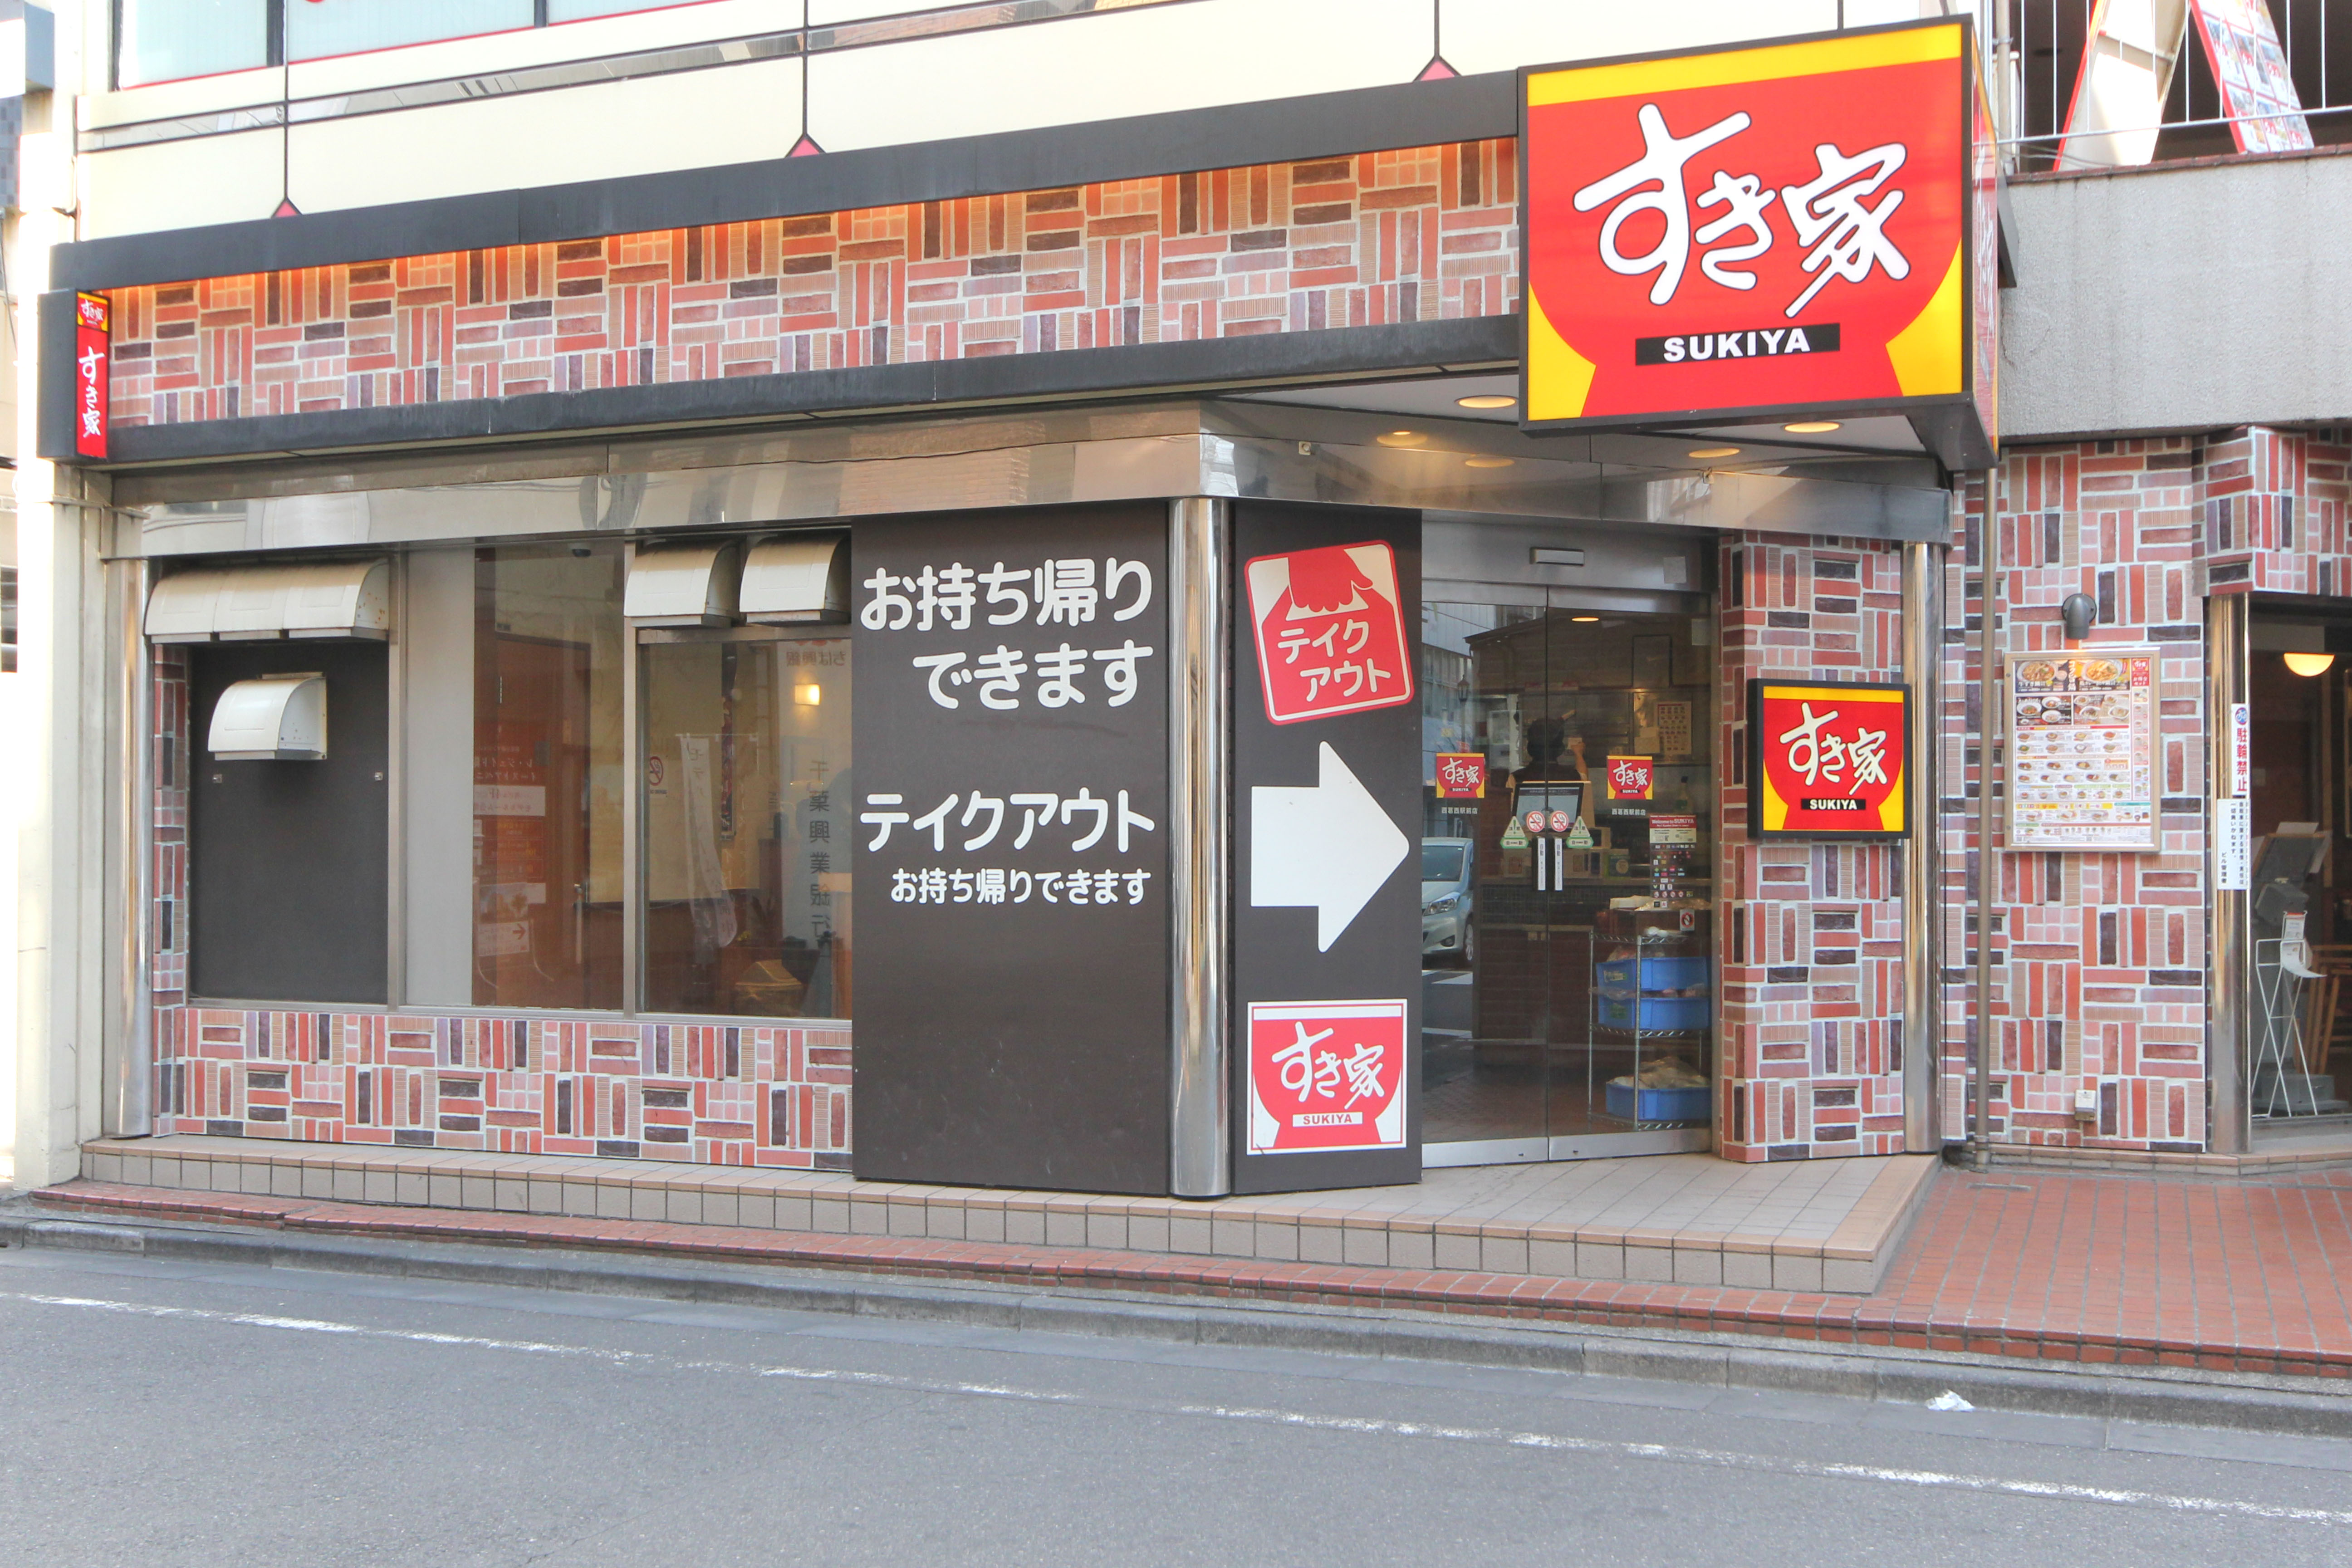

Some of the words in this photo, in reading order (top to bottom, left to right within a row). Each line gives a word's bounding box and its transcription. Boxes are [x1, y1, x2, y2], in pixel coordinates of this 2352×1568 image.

[1573, 103, 1910, 318] すき家
[81, 299, 103, 322] すき家
[1663, 326, 1811, 362] SUKIYA
[78, 345, 105, 438] すき家
[861, 557, 1152, 631] お持ち帰り
[1278, 619, 1369, 665] テイク
[912, 639, 1154, 710] できます
[1299, 658, 1391, 701] アウト
[1779, 702, 1887, 796] すき家
[2236, 727, 2247, 792] 駐輪禁止
[1442, 757, 1479, 789] すき家
[1613, 760, 1648, 789] すき家
[860, 787, 1155, 853] テイクアウト
[1809, 799, 1857, 810] SUKIYA
[891, 867, 1152, 905] お持ち帰りできます
[1271, 1020, 1385, 1110] すき家
[1302, 1113, 1353, 1125] SUKIYA
